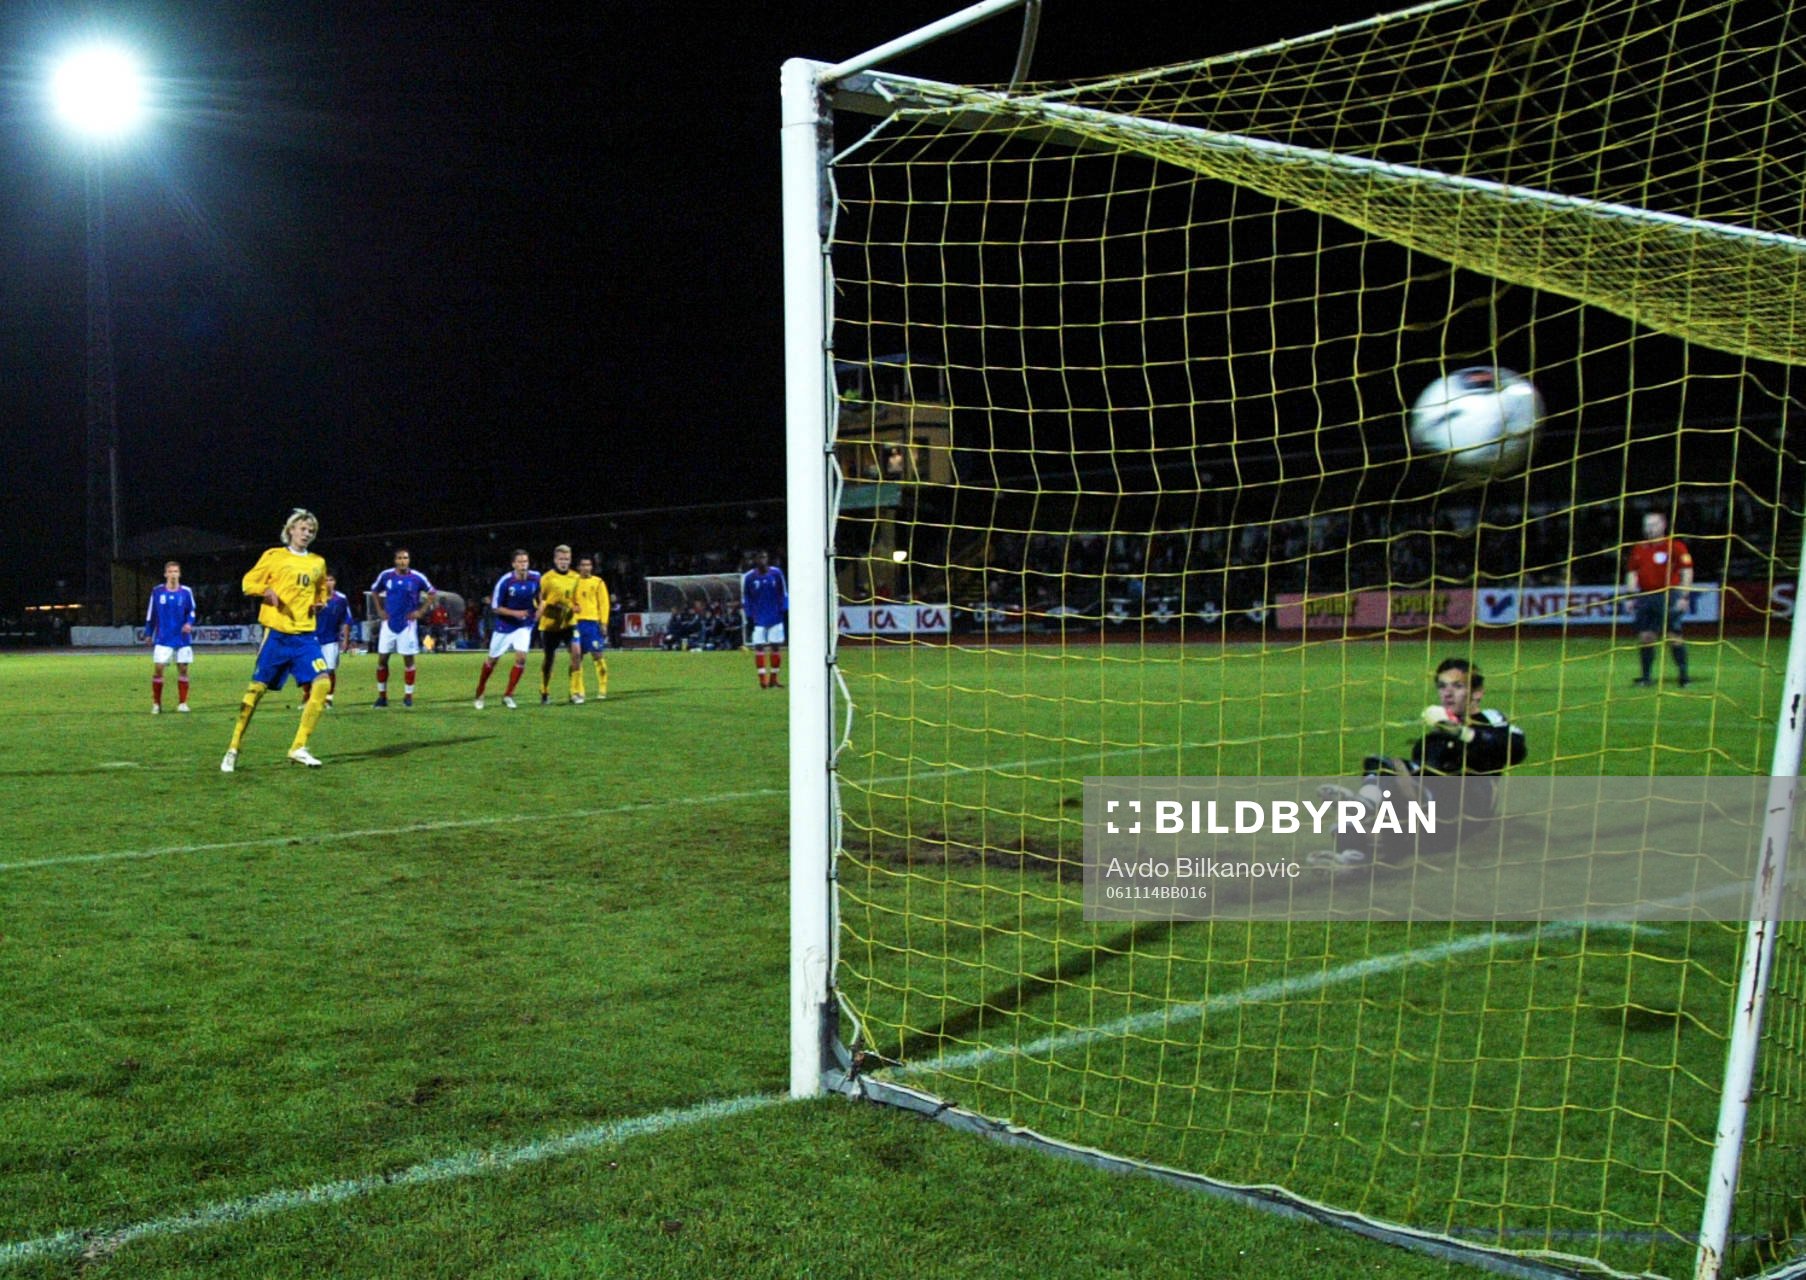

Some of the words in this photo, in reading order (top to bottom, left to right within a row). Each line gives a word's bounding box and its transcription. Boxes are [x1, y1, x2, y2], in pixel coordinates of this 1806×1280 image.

[296, 573, 310, 588] 10
[868, 608, 898, 630] ICA
[916, 608, 946, 630] ICA
